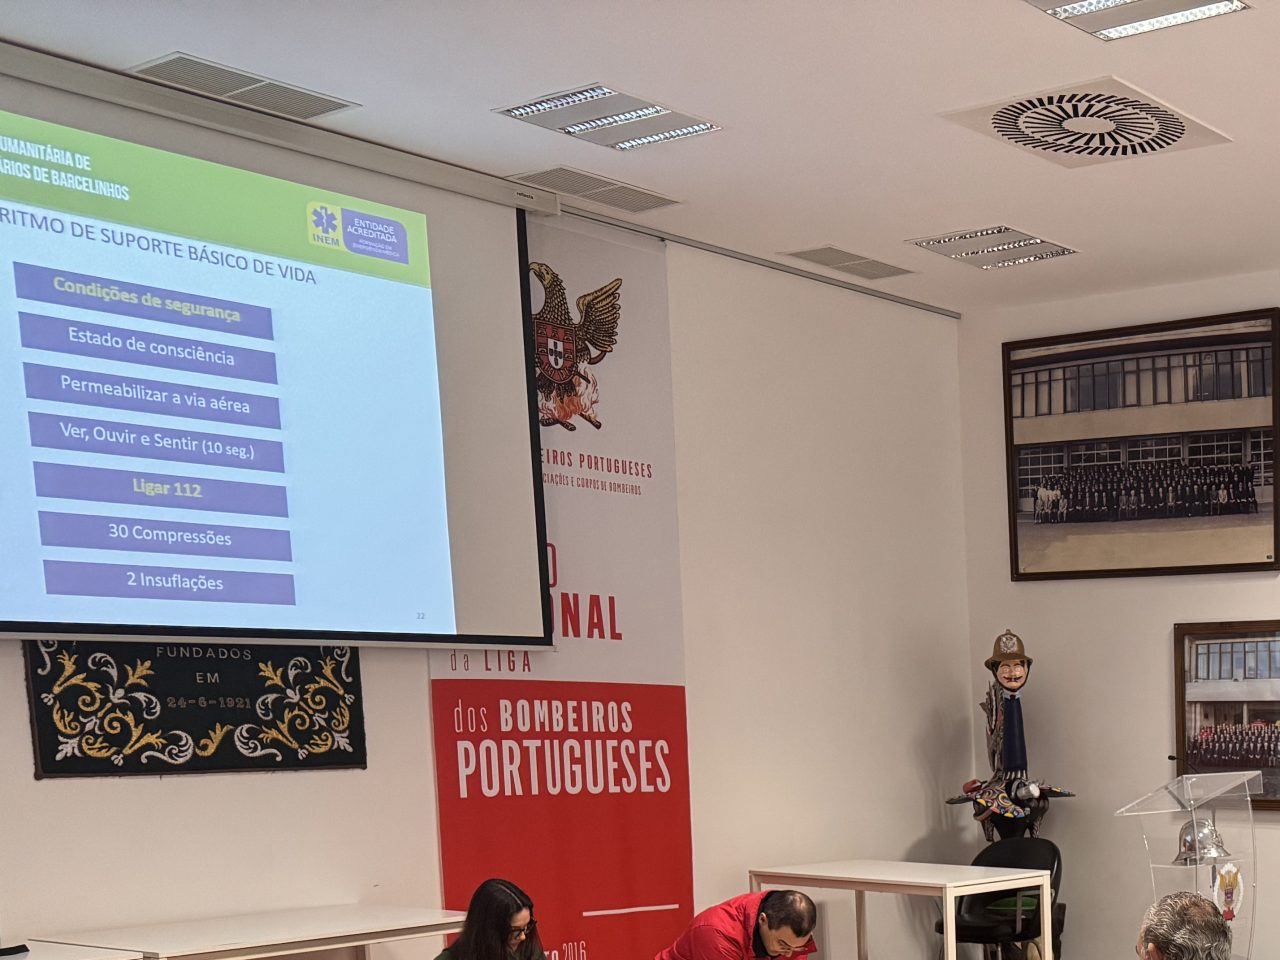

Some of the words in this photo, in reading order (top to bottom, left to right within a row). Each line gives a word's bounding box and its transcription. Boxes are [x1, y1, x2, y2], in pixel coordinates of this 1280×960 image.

[75, 153, 92, 170] DE
[32, 165, 50, 183] DE
[51, 170, 129, 201] BARCELINHOS
[347, 225, 398, 243] ACREDITADA
[354, 218, 394, 234] ENTIDADE
[312, 233, 340, 247] INEM
[71, 221, 96, 241] DE
[101, 228, 183, 258] SUPORTE
[188, 245, 248, 270] BÁSICO
[253, 259, 275, 276] DE
[278, 263, 317, 285] VIDA
[53, 276, 139, 304] Condições
[142, 292, 161, 308] de
[165, 299, 241, 324] segurança
[68, 326, 122, 348] Estado
[126, 336, 146, 352] de
[150, 343, 235, 366] consciência
[61, 374, 167, 402] Permeabilizar
[172, 393, 181, 404] a
[184, 392, 206, 408] via
[210, 395, 250, 413] aérea
[59, 422, 89, 442] Ver,
[93, 427, 136, 444] Ouvir
[140, 434, 150, 446] e
[154, 433, 198, 451] Sentir
[202, 440, 222, 456] (10
[226, 445, 255, 460] seg.)
[579, 453, 652, 478] PORTUGUESES
[132, 478, 170, 496] Ligar
[173, 482, 203, 498] 112
[609, 482, 641, 495] BOMBEIROS
[108, 523, 129, 538] 30
[132, 525, 232, 545] Compressões
[126, 572, 137, 586] 2
[140, 572, 224, 592] Insuflações
[550, 592, 623, 641] NAL
[156, 646, 252, 660] FUNDADOS
[450, 649, 469, 671] da
[484, 649, 531, 672] LIGA
[195, 672, 220, 683] EM
[454, 698, 488, 733] dos
[499, 698, 633, 733] BOMBEIROS
[456, 738, 671, 798] PORTUGUESES
